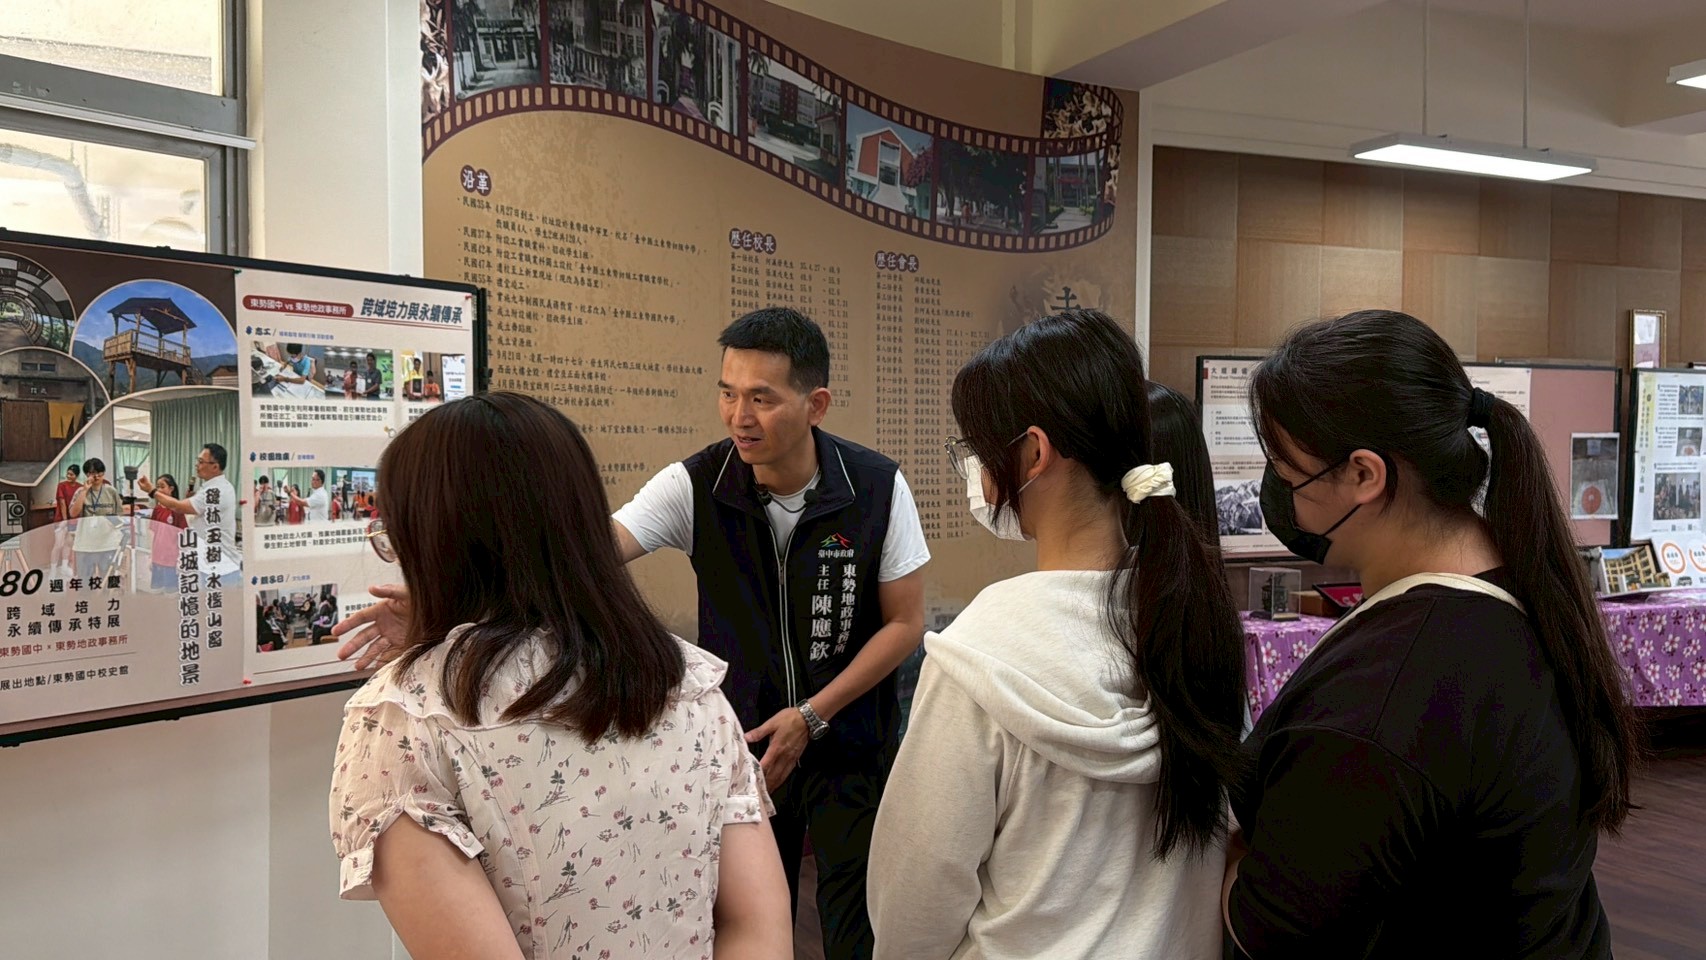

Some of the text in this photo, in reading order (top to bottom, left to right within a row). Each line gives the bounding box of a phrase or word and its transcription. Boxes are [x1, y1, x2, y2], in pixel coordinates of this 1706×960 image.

[462, 169, 489, 193] 沿革
[731, 230, 775, 252] 歷任校長
[876, 252, 918, 271] 歷任會長
[360, 297, 463, 325] 跨域培力與永續傳承
[818, 548, 855, 559] 臺中市政府
[0, 569, 121, 597] 80 週年校慶
[817, 564, 830, 591] 主任
[6, 598, 120, 621] 跨域培力
[179, 529, 200, 685] 山城記憶的地景
[833, 563, 857, 656] 東勢地政事務所
[7, 614, 120, 638] 永續傳承特展
[809, 594, 833, 661] 陳應欽
[0, 643, 43, 658] 東勢國中
[55, 634, 128, 652] 東勢地政事務所
[0, 665, 129, 691] 展出地點/東勢國中校史館
